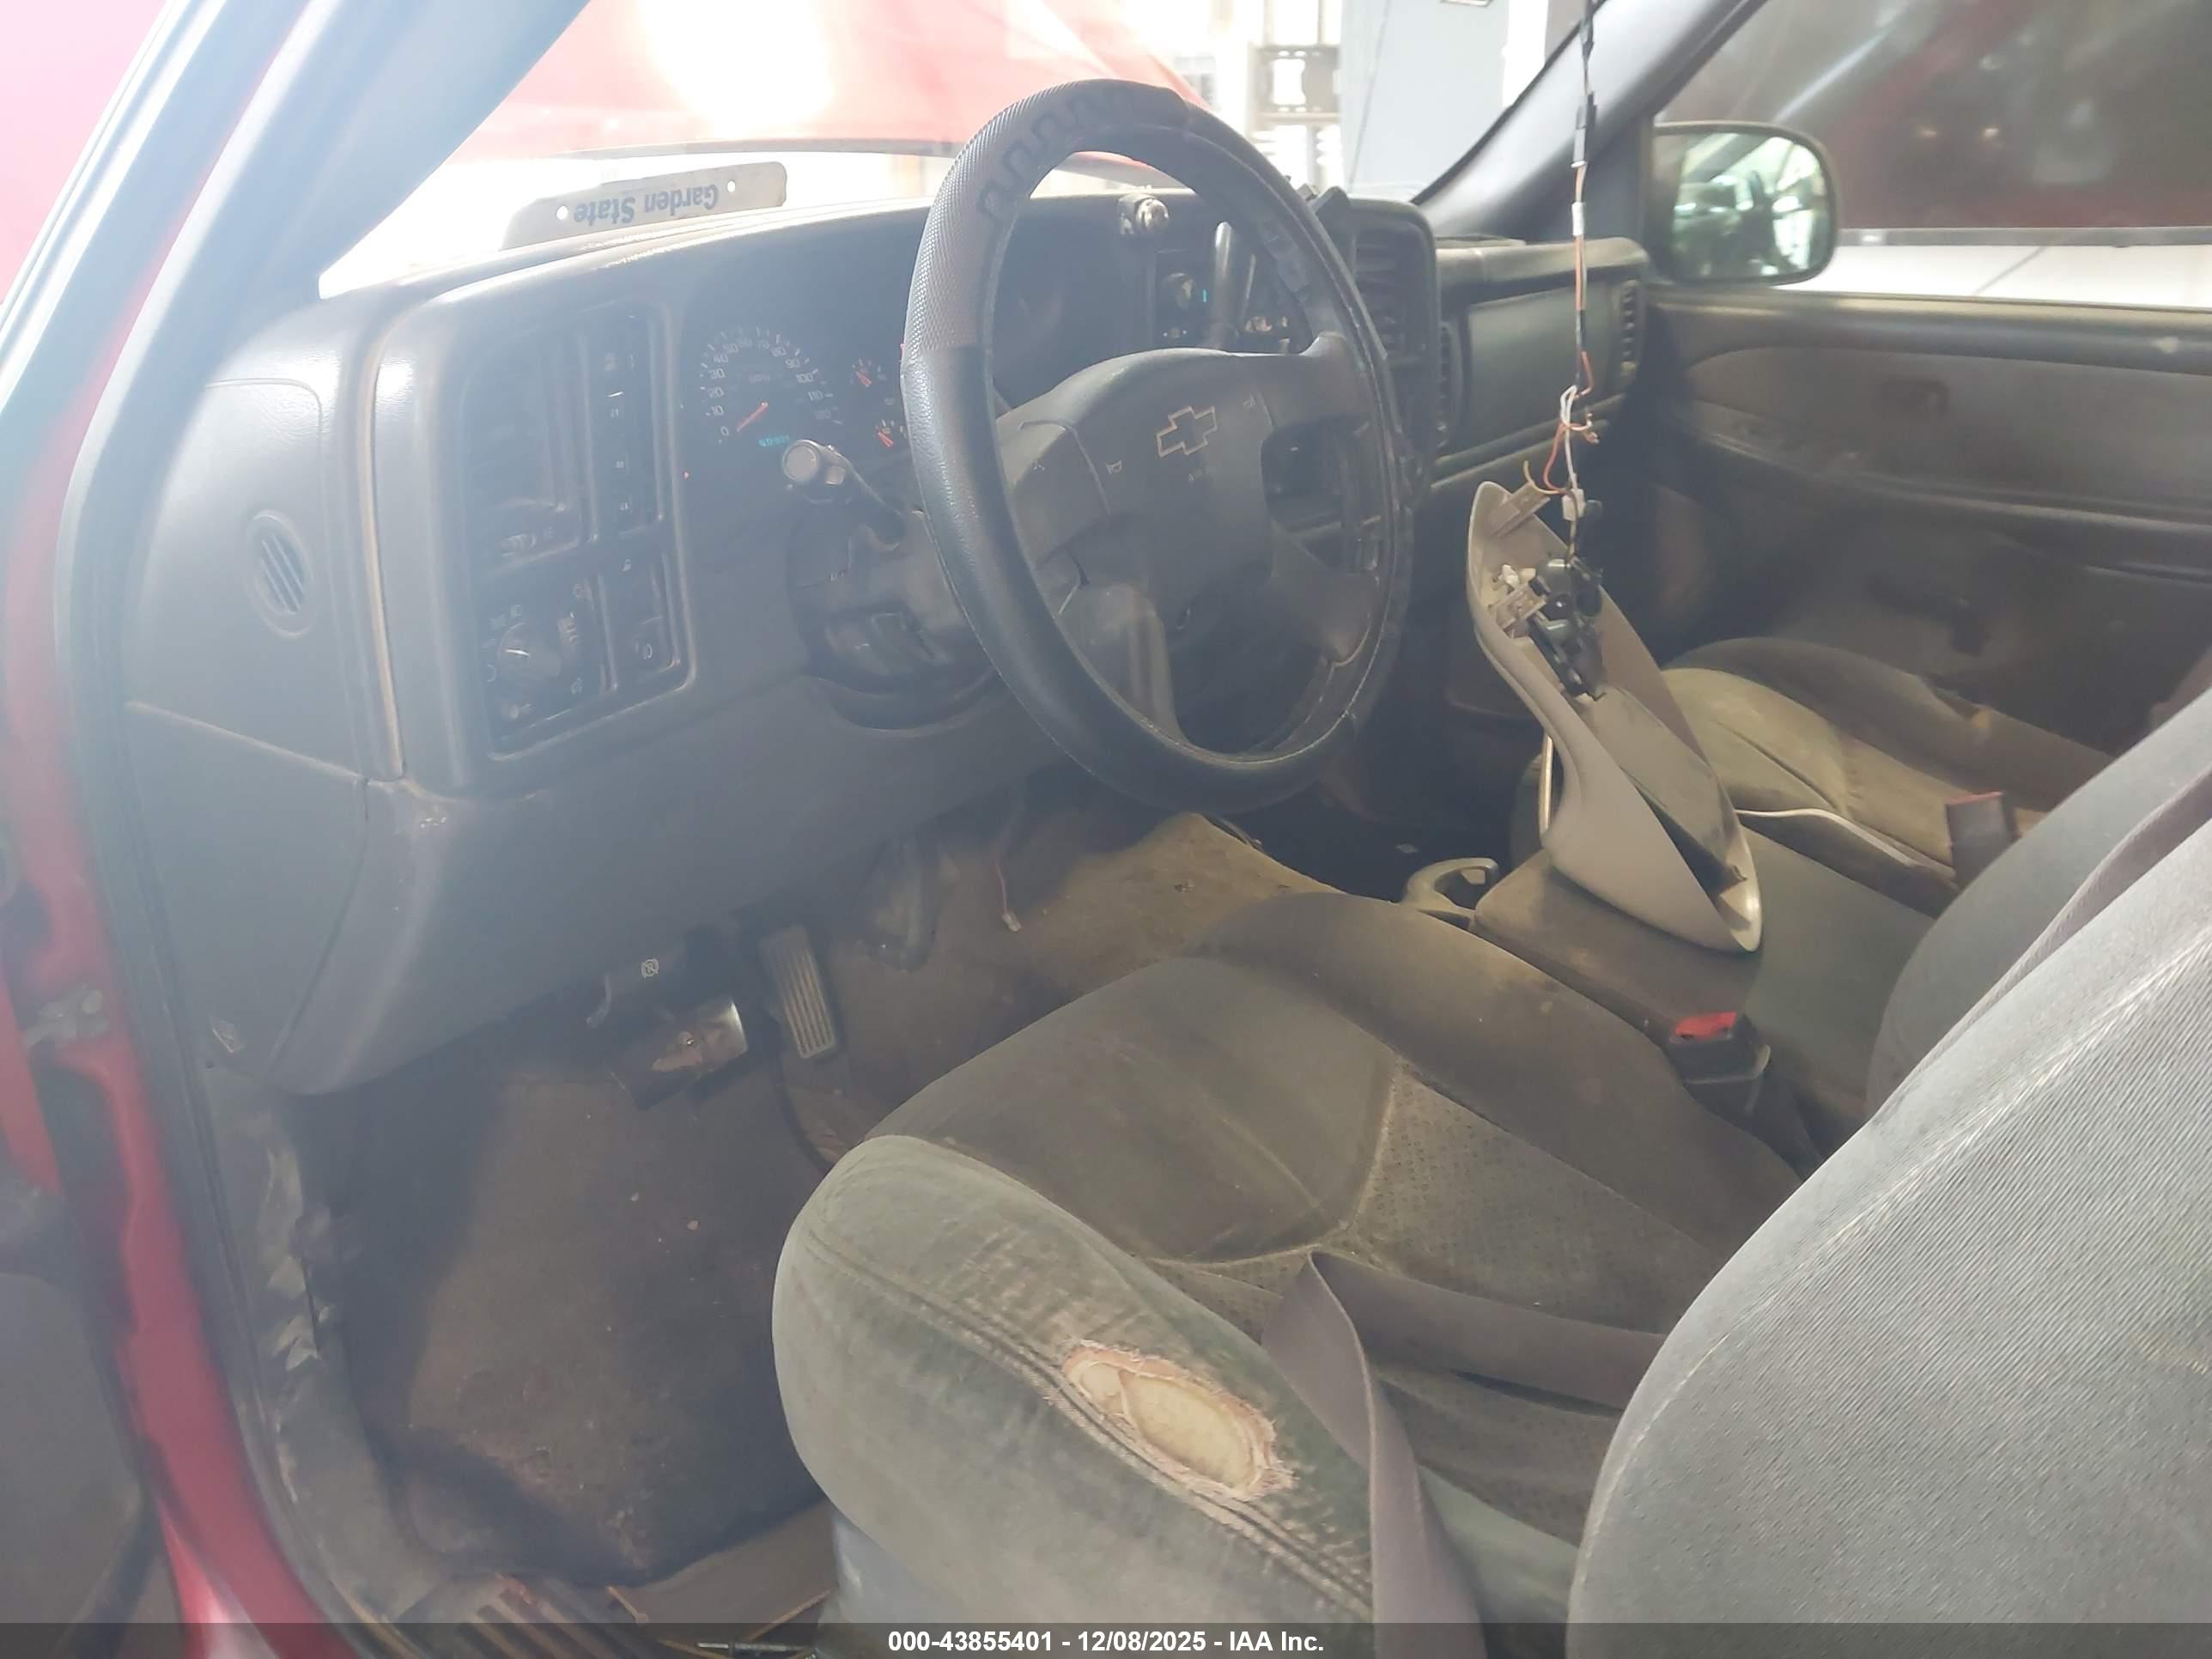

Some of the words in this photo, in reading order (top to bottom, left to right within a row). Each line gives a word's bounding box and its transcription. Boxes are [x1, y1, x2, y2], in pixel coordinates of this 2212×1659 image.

[644, 184, 720, 216] Garden
[574, 196, 635, 226] State
[722, 343, 738, 355] 50
[770, 346, 787, 357] 80
[713, 353, 728, 363] 40
[784, 359, 800, 369] 90
[708, 368, 726, 380] 30
[708, 386, 724, 398] 20
[808, 391, 823, 401] 110
[711, 405, 725, 416] 10
[720, 425, 729, 436] 0
